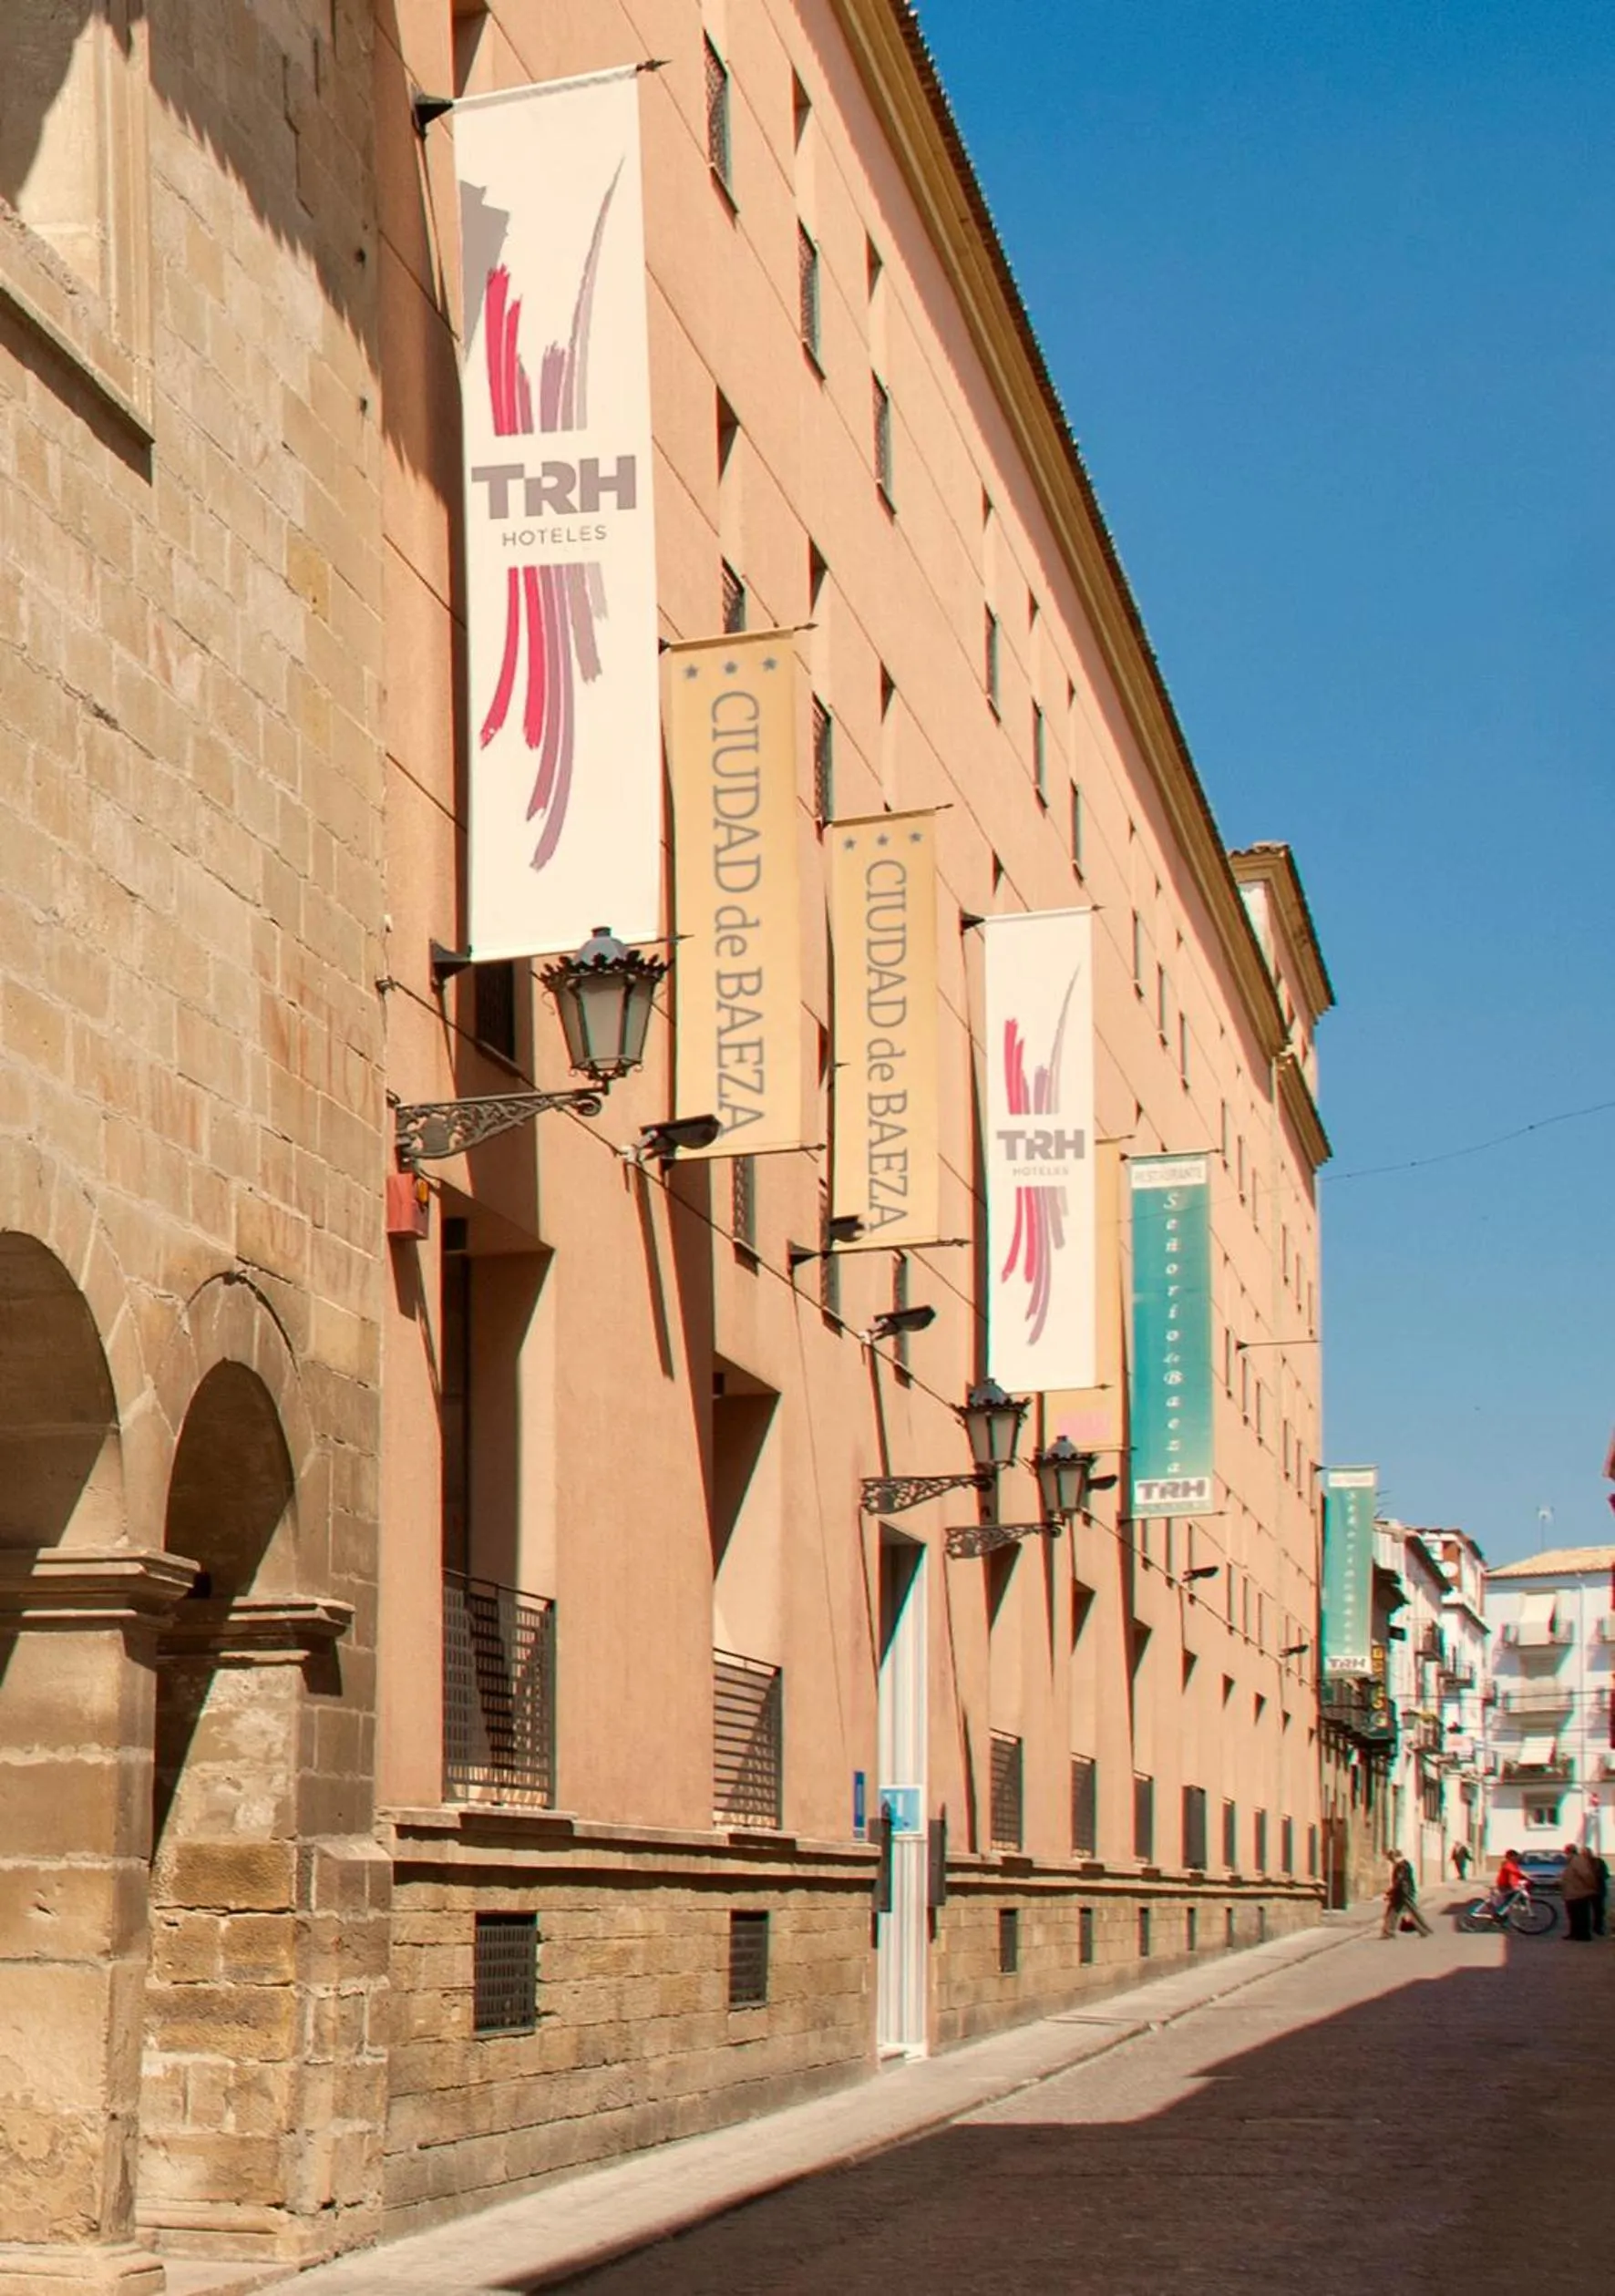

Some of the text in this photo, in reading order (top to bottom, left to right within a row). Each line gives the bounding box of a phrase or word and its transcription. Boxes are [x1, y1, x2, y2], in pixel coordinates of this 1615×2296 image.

[471, 454, 636, 520] TRH
[501, 524, 608, 547] HOTELES
[710, 690, 765, 1137] CIUDAD de BAEZA
[865, 860, 909, 1233] CIUDAD de BAEZA
[996, 1128, 1085, 1160] TRH
[1013, 1166, 1069, 1177] HOTELES
[1137, 1479, 1206, 1500] TRH
